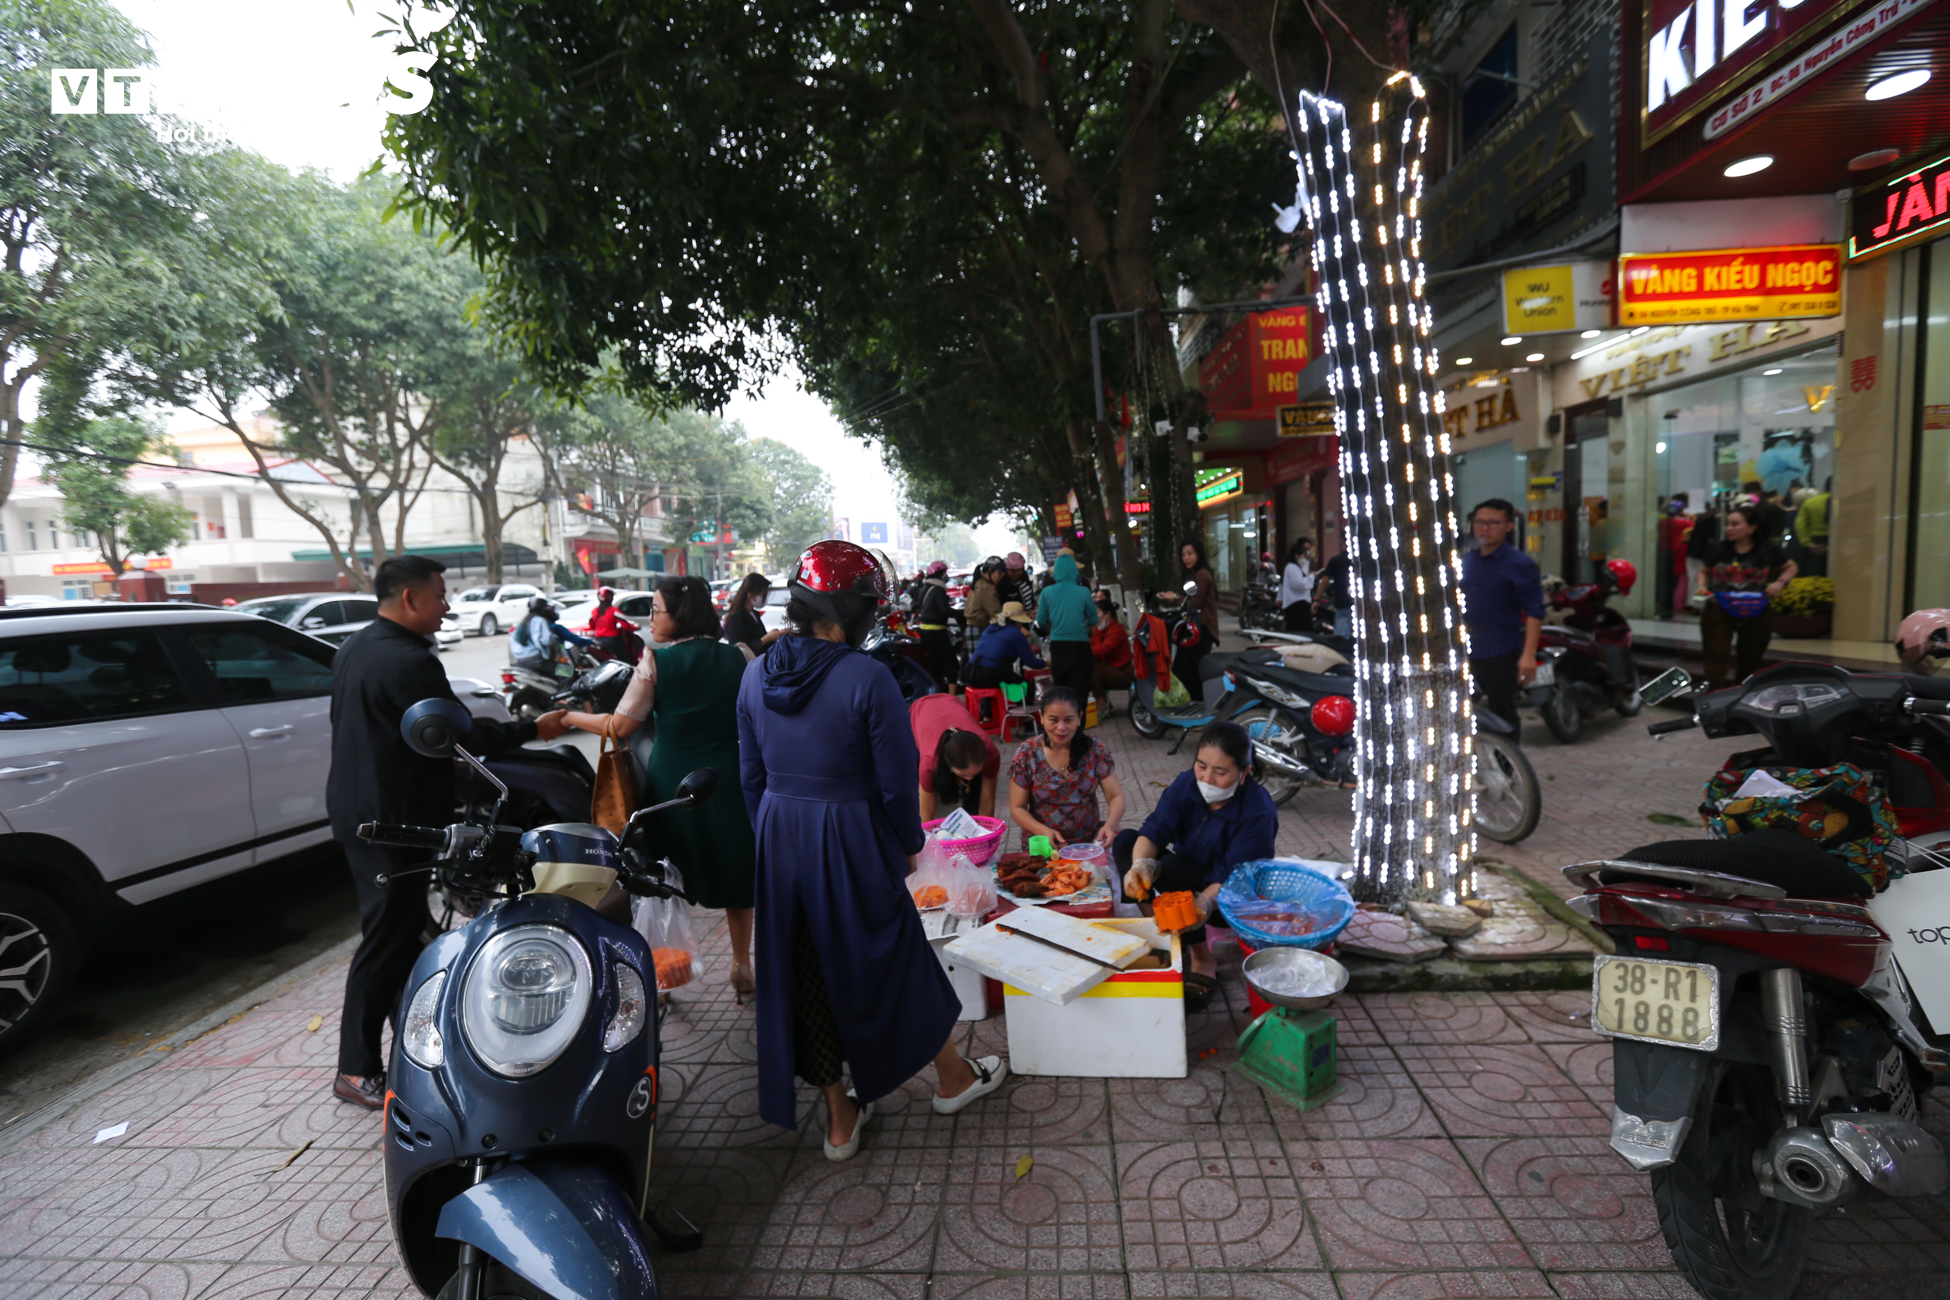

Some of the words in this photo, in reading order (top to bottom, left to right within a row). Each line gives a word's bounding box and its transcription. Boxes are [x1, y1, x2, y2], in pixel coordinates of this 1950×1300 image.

[1752, 87, 1763, 106] 2
[1631, 264, 1698, 295] VÀNG
[1766, 259, 1834, 291] NGỌC
[1259, 314, 1296, 328] VÀNG
[1524, 306, 1557, 317] Union
[1580, 344, 1692, 398] VIỆT
[1475, 376, 1522, 432] HÀ
[585, 848, 613, 859] HONDA
[1612, 962, 1698, 1003] 38-R1
[1613, 997, 1700, 1042] 1888
